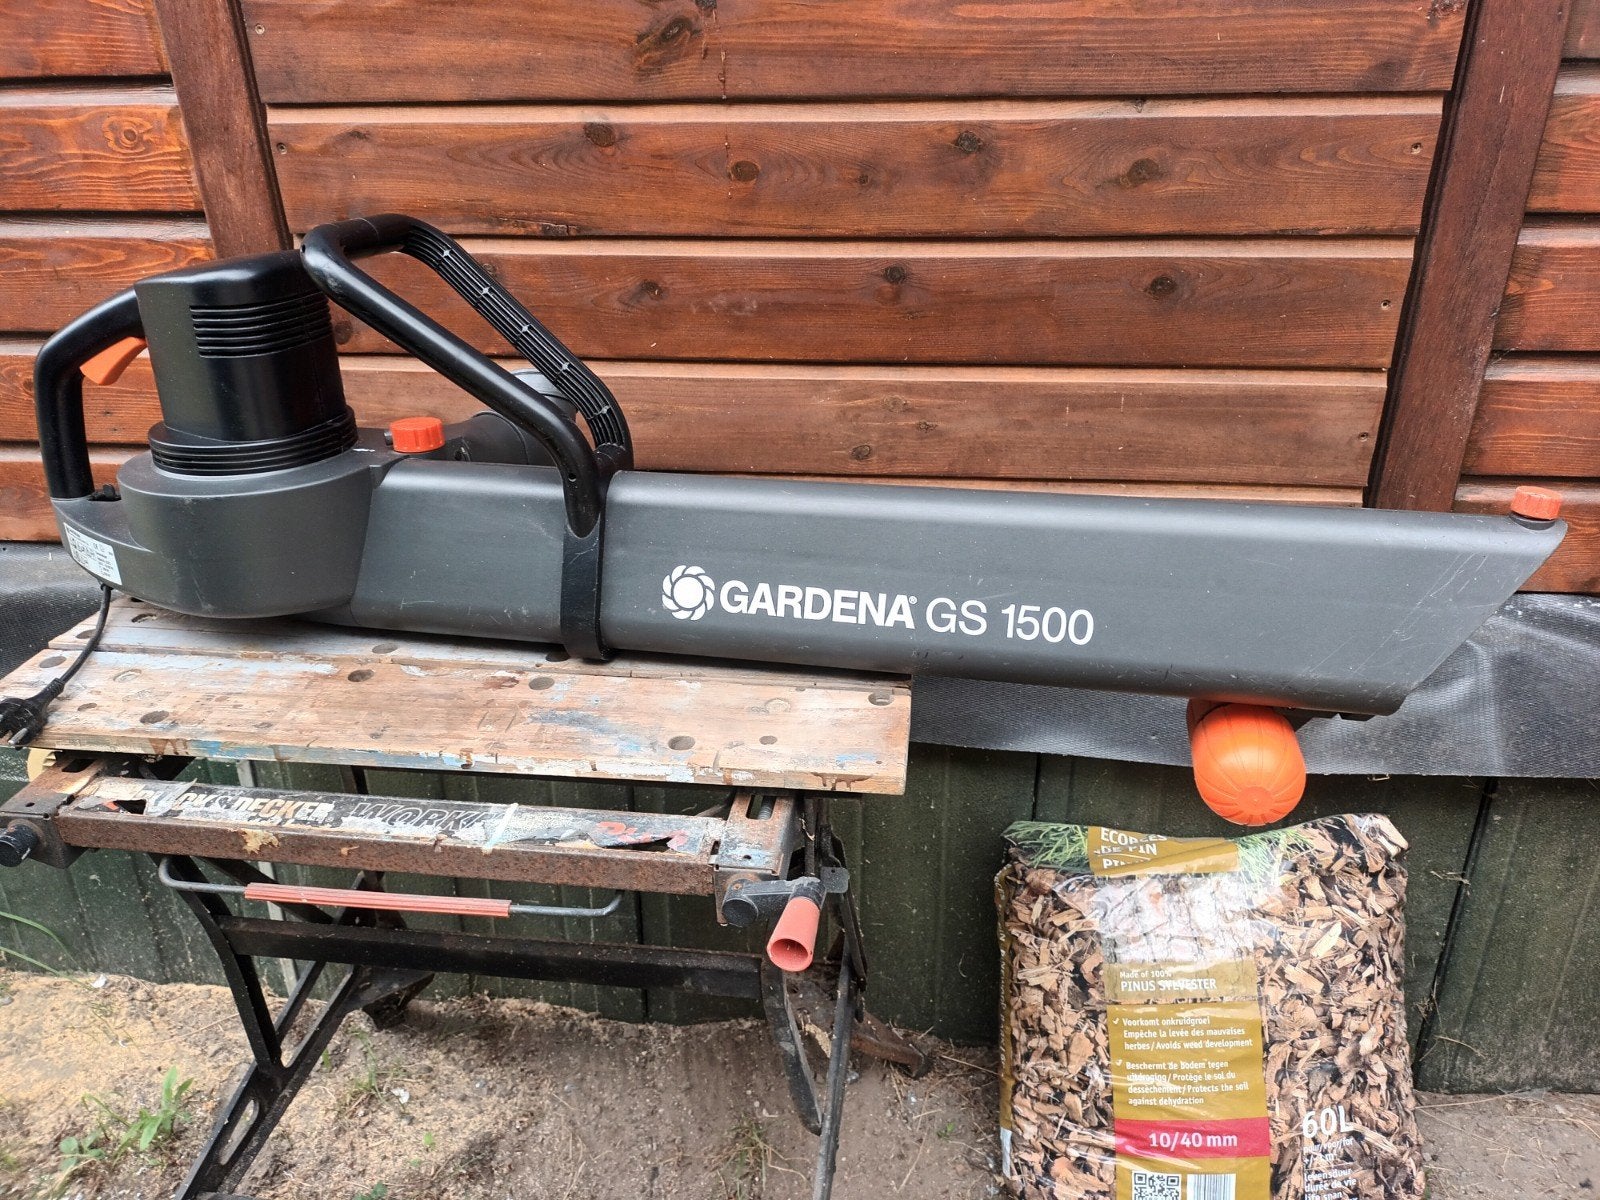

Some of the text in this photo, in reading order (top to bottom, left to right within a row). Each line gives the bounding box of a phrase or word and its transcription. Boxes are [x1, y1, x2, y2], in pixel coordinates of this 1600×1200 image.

[925, 597, 988, 636] GS
[1001, 603, 1095, 646] 1500
[1120, 971, 1139, 979] Made
[1141, 970, 1149, 978] of
[1121, 980, 1156, 992] PINUS
[1122, 1016, 1210, 1027] Voorkomt onkruidgroei
[1123, 1027, 1245, 1039] Empêche la levée des mauvaises
[1183, 1040, 1203, 1049] weed
[1205, 1039, 1253, 1049] development
[1126, 1060, 1229, 1070] Beschermt de bodem tegen
[1204, 1073, 1211, 1081] le
[1213, 1072, 1224, 1080] sol
[1226, 1071, 1236, 1079] du
[1221, 1083, 1234, 1091] the
[1235, 1081, 1249, 1091] soil
[1128, 1097, 1204, 1107] against dehydration
[1149, 1131, 1238, 1152] 10/40 mm
